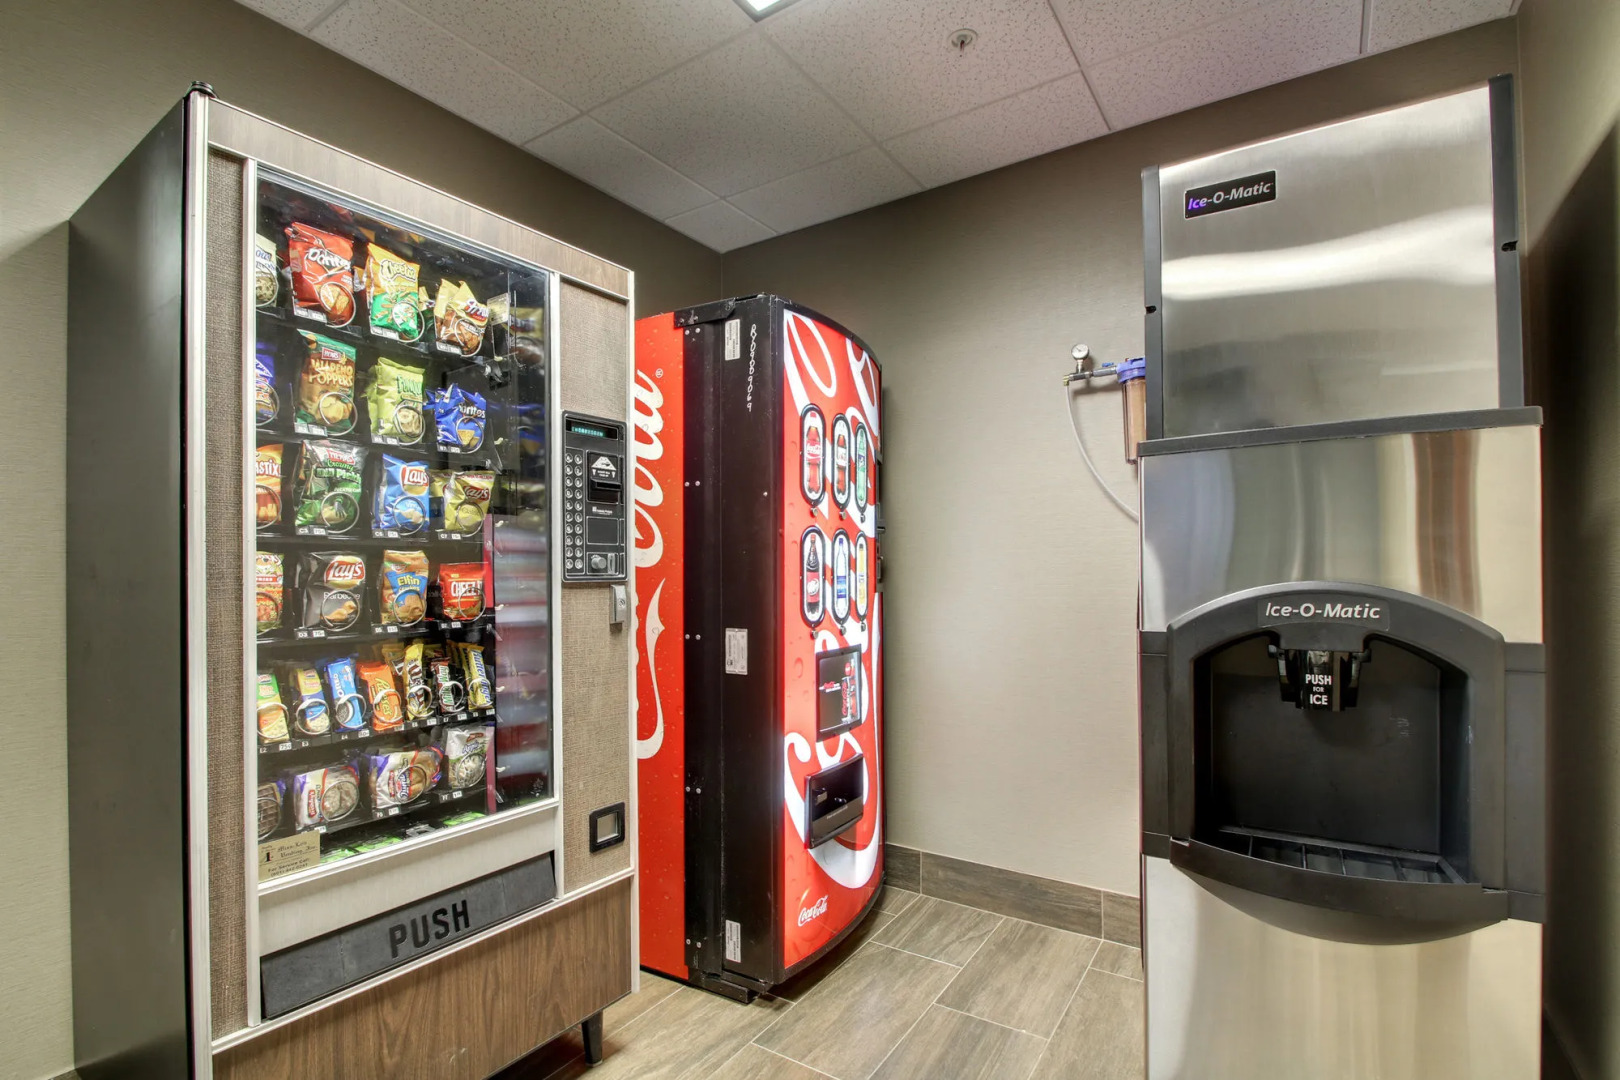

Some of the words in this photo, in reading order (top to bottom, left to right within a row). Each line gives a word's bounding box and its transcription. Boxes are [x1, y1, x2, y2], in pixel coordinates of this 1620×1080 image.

[1188, 182, 1271, 210] Ice-O-Matic
[327, 562, 363, 581] Lay's
[397, 575, 420, 587] Elfin
[1265, 602, 1381, 619] Ice-O-Matic
[1305, 673, 1332, 686] PUSH
[1309, 694, 1328, 706] ICE
[388, 899, 471, 959] PUSH
